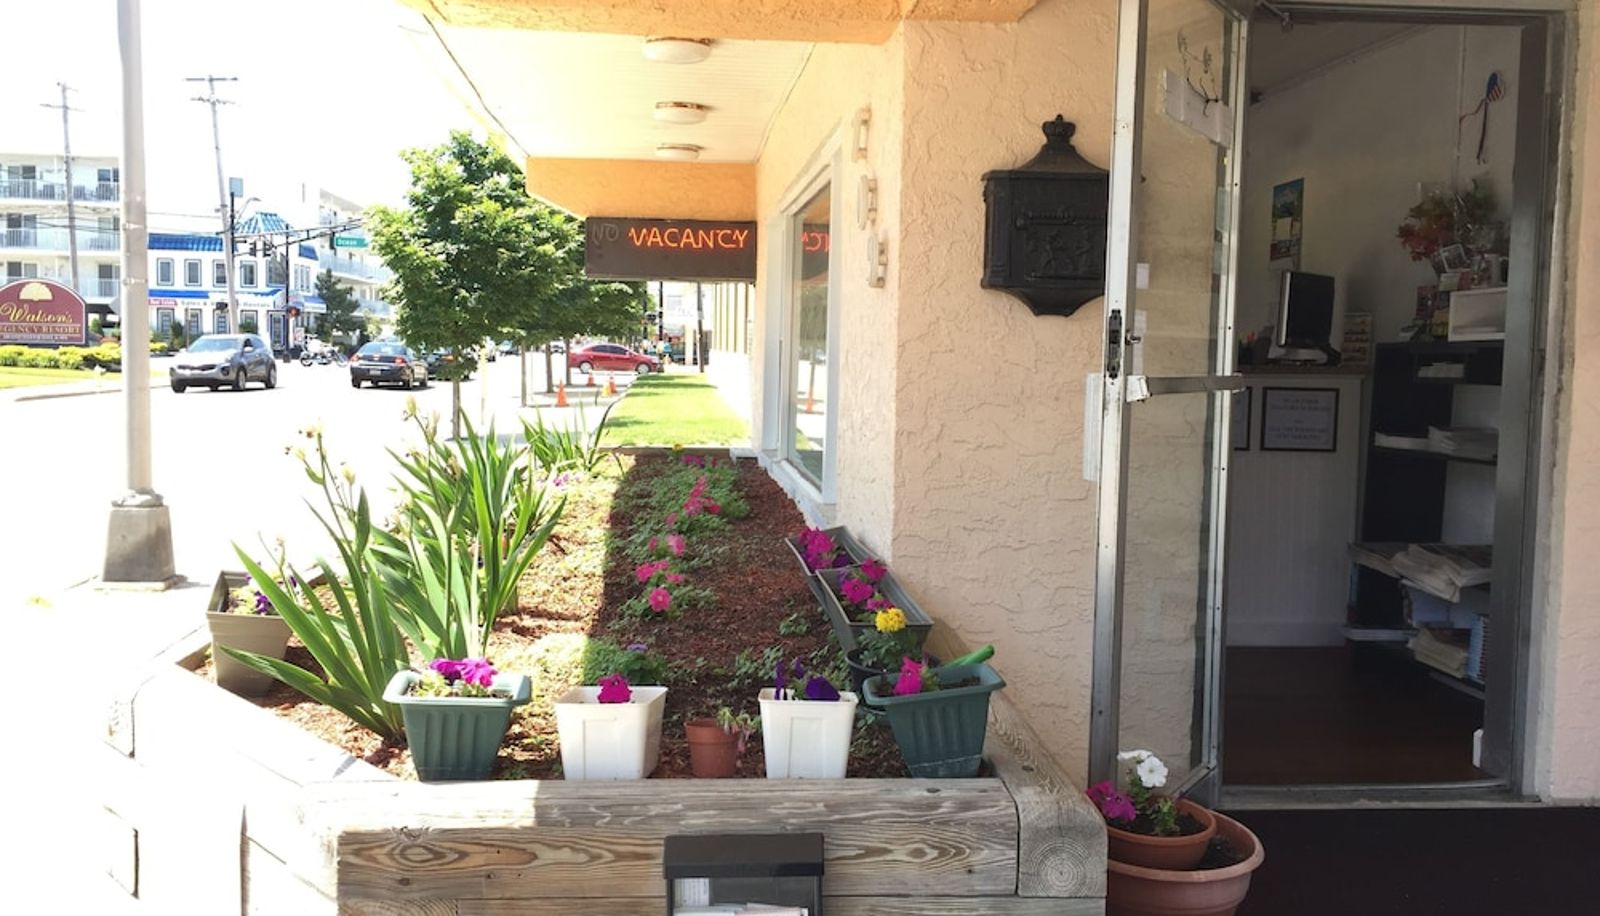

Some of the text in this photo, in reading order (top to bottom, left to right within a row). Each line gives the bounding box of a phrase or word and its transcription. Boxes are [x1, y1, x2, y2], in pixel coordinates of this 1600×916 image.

[592, 223, 748, 248] NO VACANCY
[0, 302, 73, 323] Watson's
